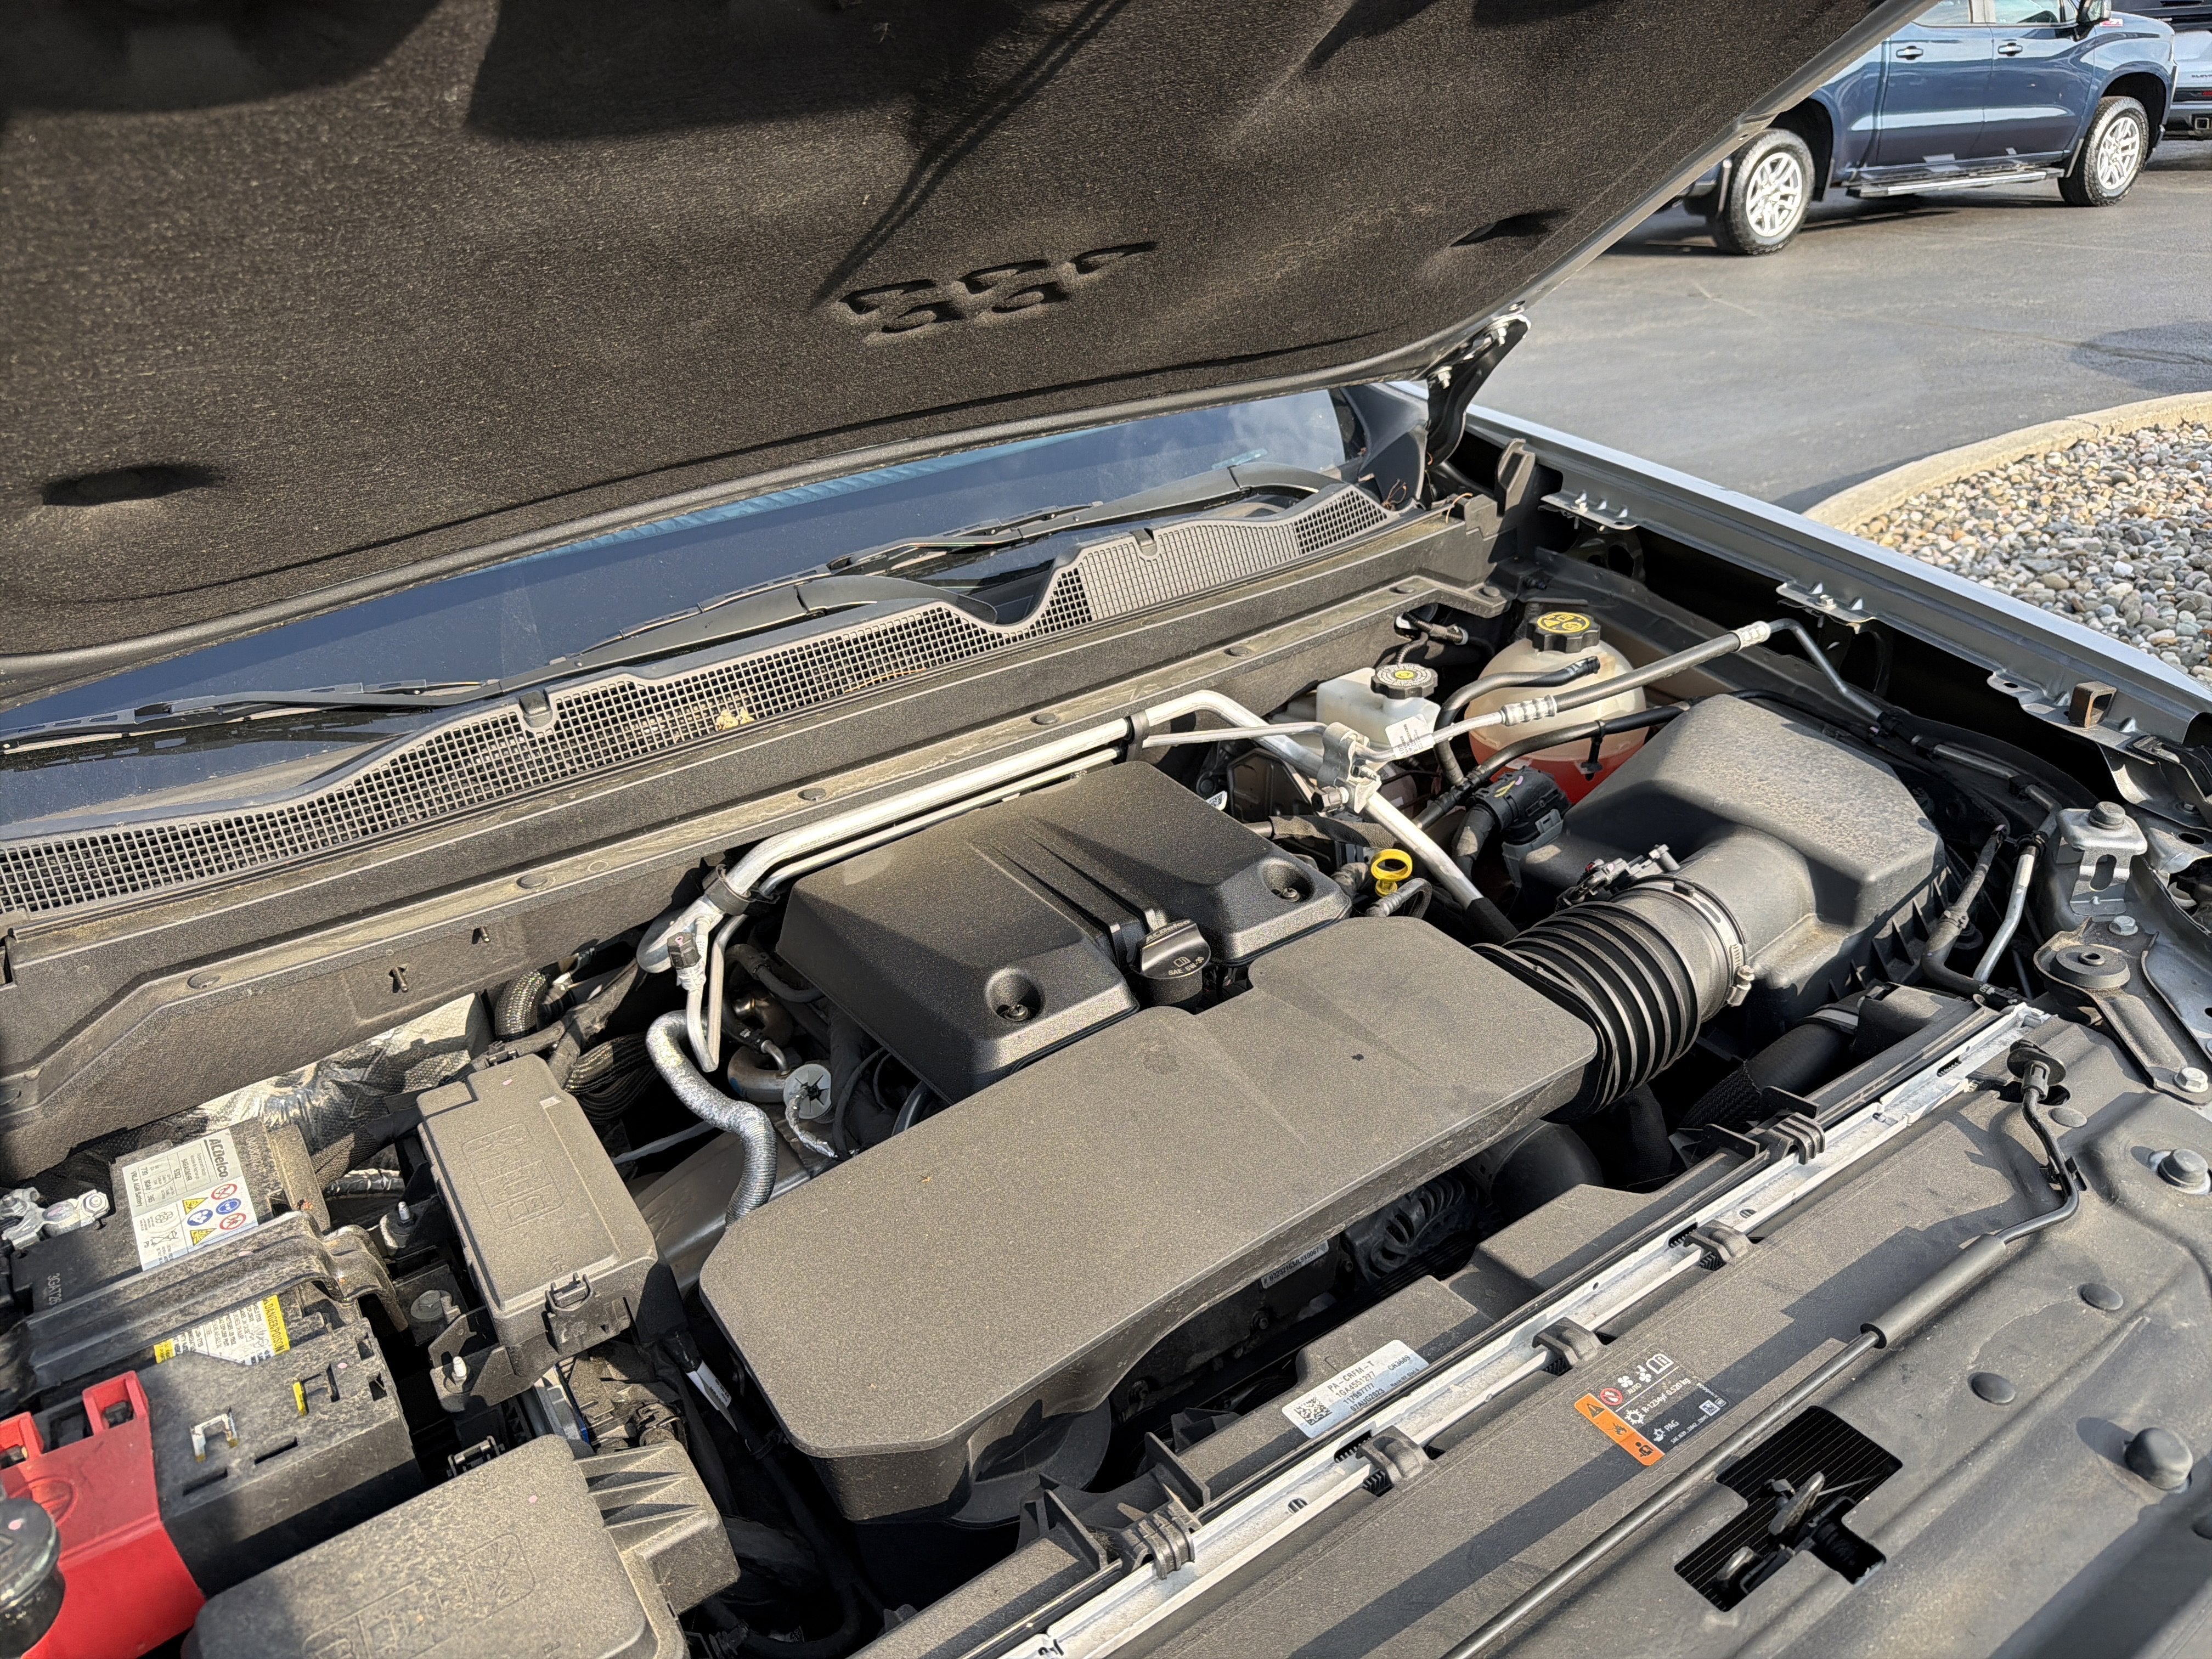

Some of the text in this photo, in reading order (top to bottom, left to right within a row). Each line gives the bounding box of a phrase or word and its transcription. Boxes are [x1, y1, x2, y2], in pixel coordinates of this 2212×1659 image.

[1146, 920, 1190, 943] ACDelco
[1185, 956, 1204, 971] 5W-30
[209, 1138, 229, 1178] ACDelco
[47, 1273, 62, 1305] 3GAT26
[264, 1303, 285, 1352] DANGER/POISON
[1335, 1372, 1376, 1397] 1GA4551277
[1627, 1383, 1641, 1395] AUTO
[1641, 1378, 1691, 1413] R-1234yf 0.520 kg
[1350, 1389, 1385, 1412] 07AUG2023
[1664, 1419, 1679, 1431] PAG
